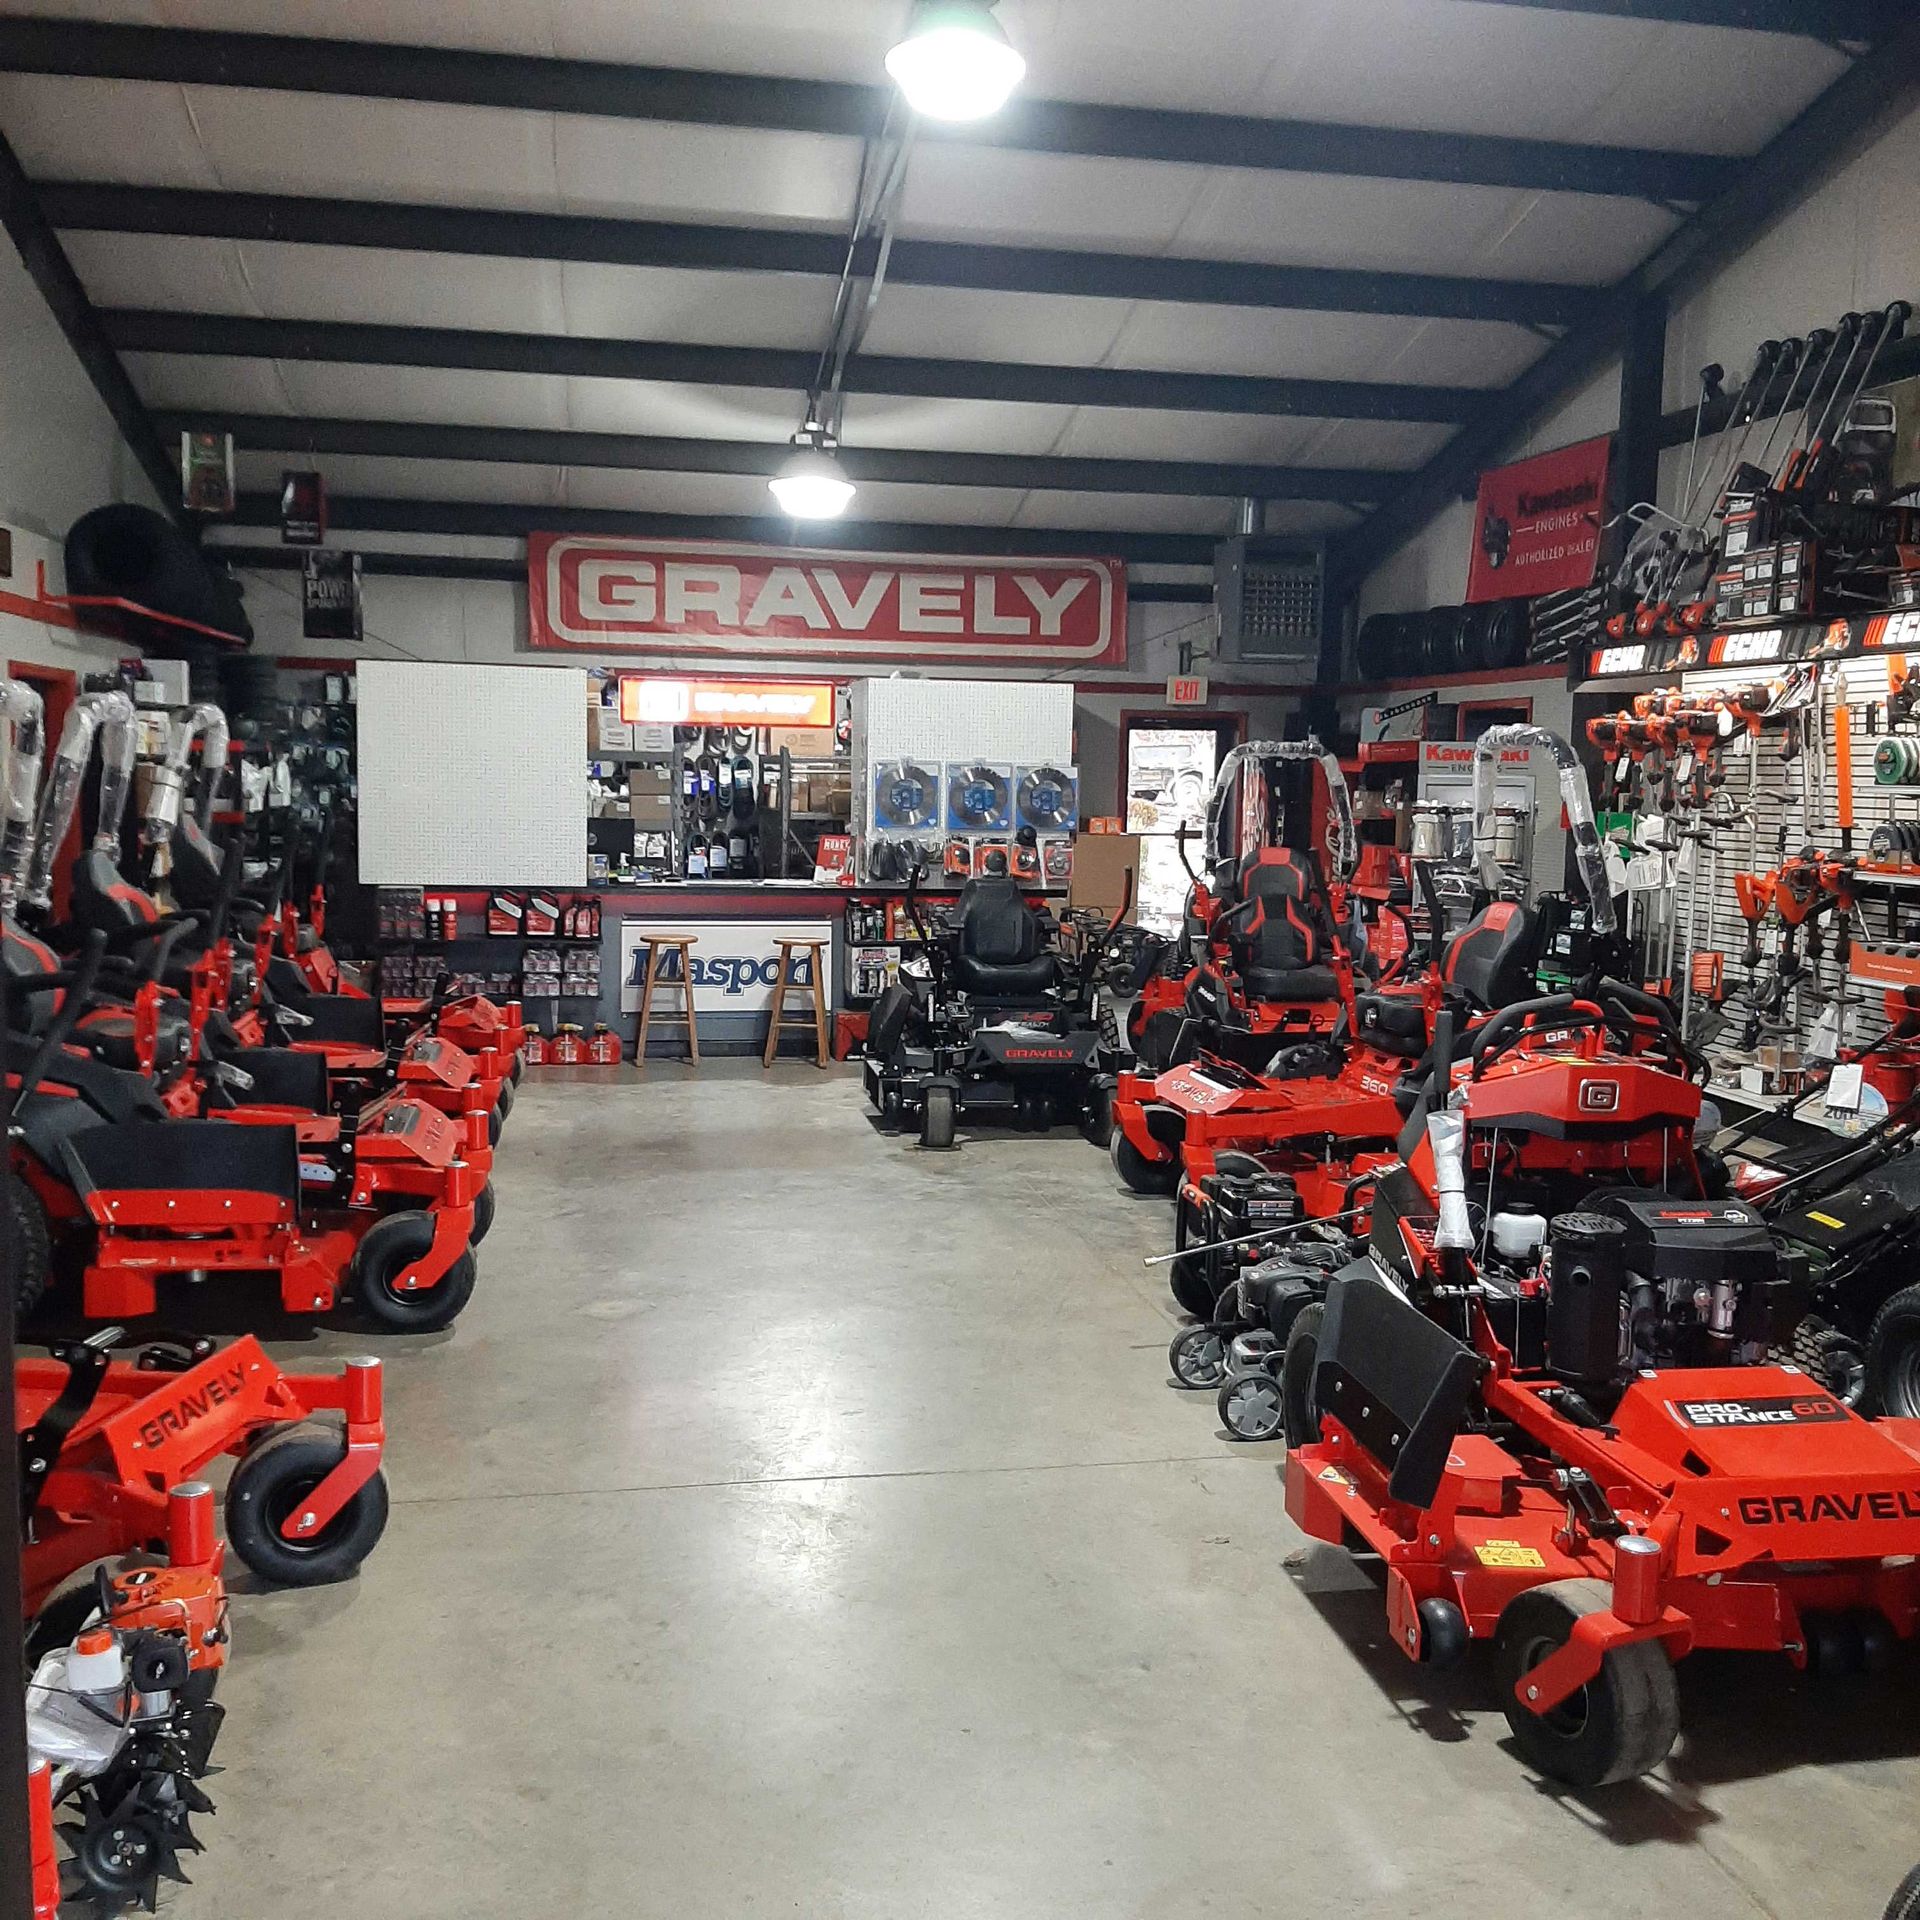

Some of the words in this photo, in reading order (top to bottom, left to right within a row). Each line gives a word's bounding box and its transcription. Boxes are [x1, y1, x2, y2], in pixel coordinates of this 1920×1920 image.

[1535, 512, 1579, 533] ENGINES
[1514, 546, 1564, 567] AUTHORIZED
[578, 559, 1089, 635] GRAVELY
[1722, 630, 1782, 662] ECHO
[1599, 645, 1646, 673] ECHO
[1175, 680, 1200, 701] EXIT
[1426, 744, 1529, 762] Kawaki
[1451, 765, 1502, 773] ENGS
[1005, 1048, 1074, 1059] GRAVELY
[1360, 1074, 1389, 1096] 360
[1369, 1243, 1409, 1294] GRAVELY
[139, 1362, 245, 1450] GRAVELY
[1684, 1402, 1750, 1415] PRO-
[1791, 1401, 1836, 1415] 60
[1689, 1410, 1798, 1424] STANCE
[1738, 1490, 1920, 1525] GRAVEL
